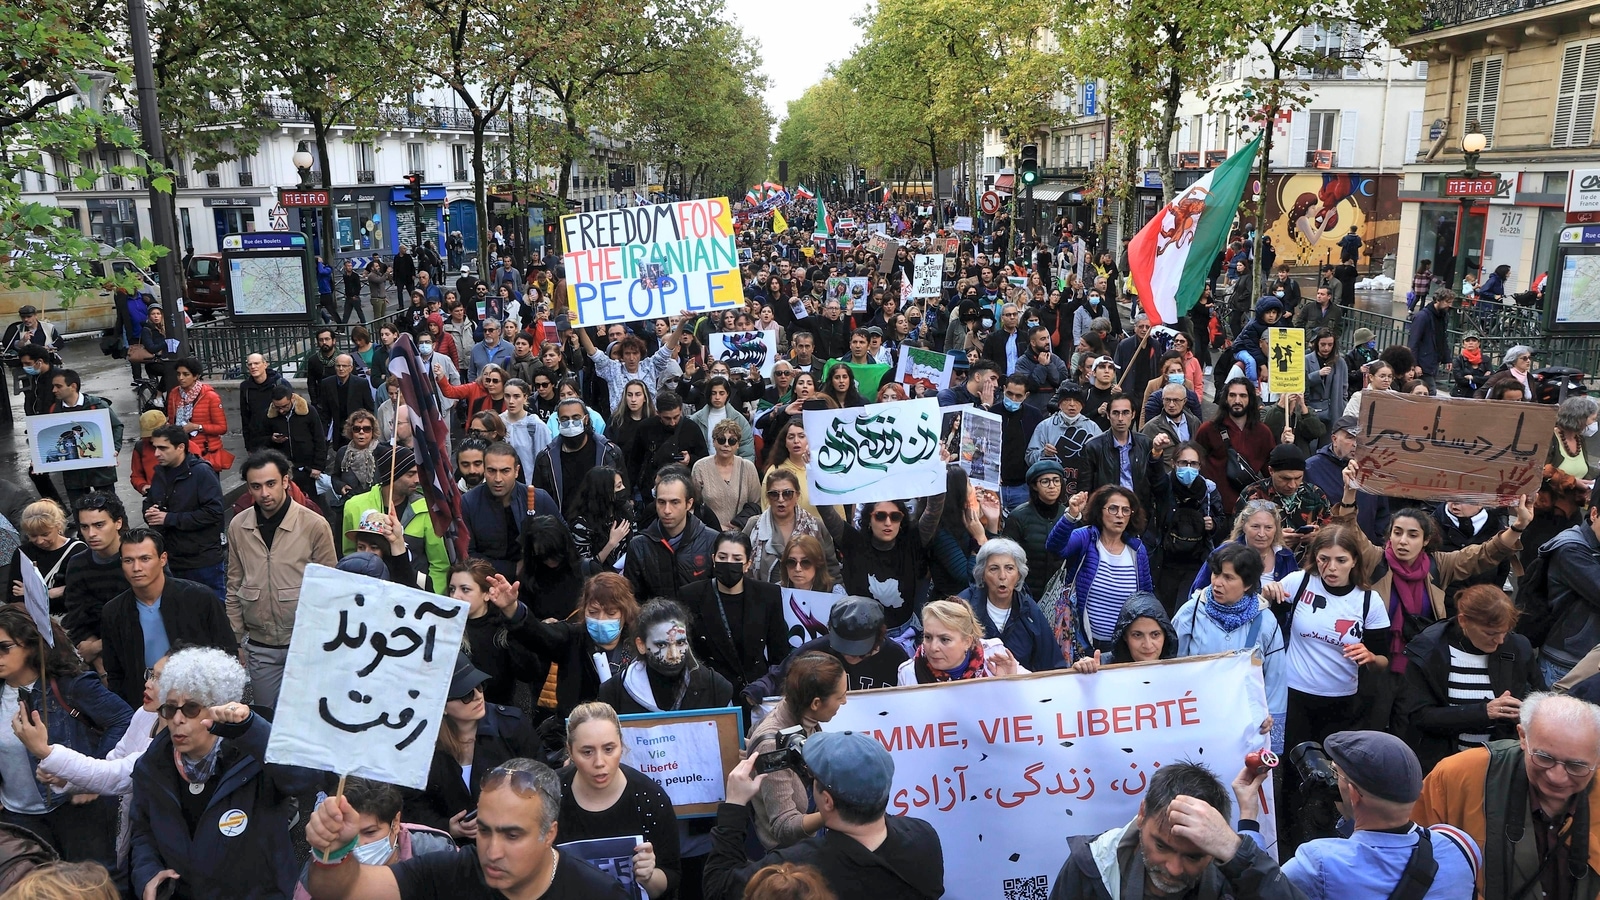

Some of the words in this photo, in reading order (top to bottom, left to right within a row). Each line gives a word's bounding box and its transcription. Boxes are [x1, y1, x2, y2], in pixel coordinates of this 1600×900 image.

[1086, 80, 1095, 115] OTEL
[284, 193, 327, 205] METRO
[1449, 181, 1493, 193] METRO
[562, 204, 681, 253] FREEDOM
[677, 199, 728, 241] FOR
[1499, 226, 1521, 234] 6h-22h
[1501, 211, 1523, 227] 7j/7
[565, 247, 621, 284] THE
[923, 256, 935, 266] Je
[573, 270, 736, 325] PEOPLE
[322, 593, 462, 678] آخوند
[318, 689, 428, 751] رفت
[978, 714, 1044, 747] VIE,
[1056, 690, 1201, 740] LIBERTÉ
[635, 733, 677, 746] Femme
[640, 760, 679, 773] Liberté
[648, 749, 666, 760] Vie
[893, 764, 969, 817] آزادی
